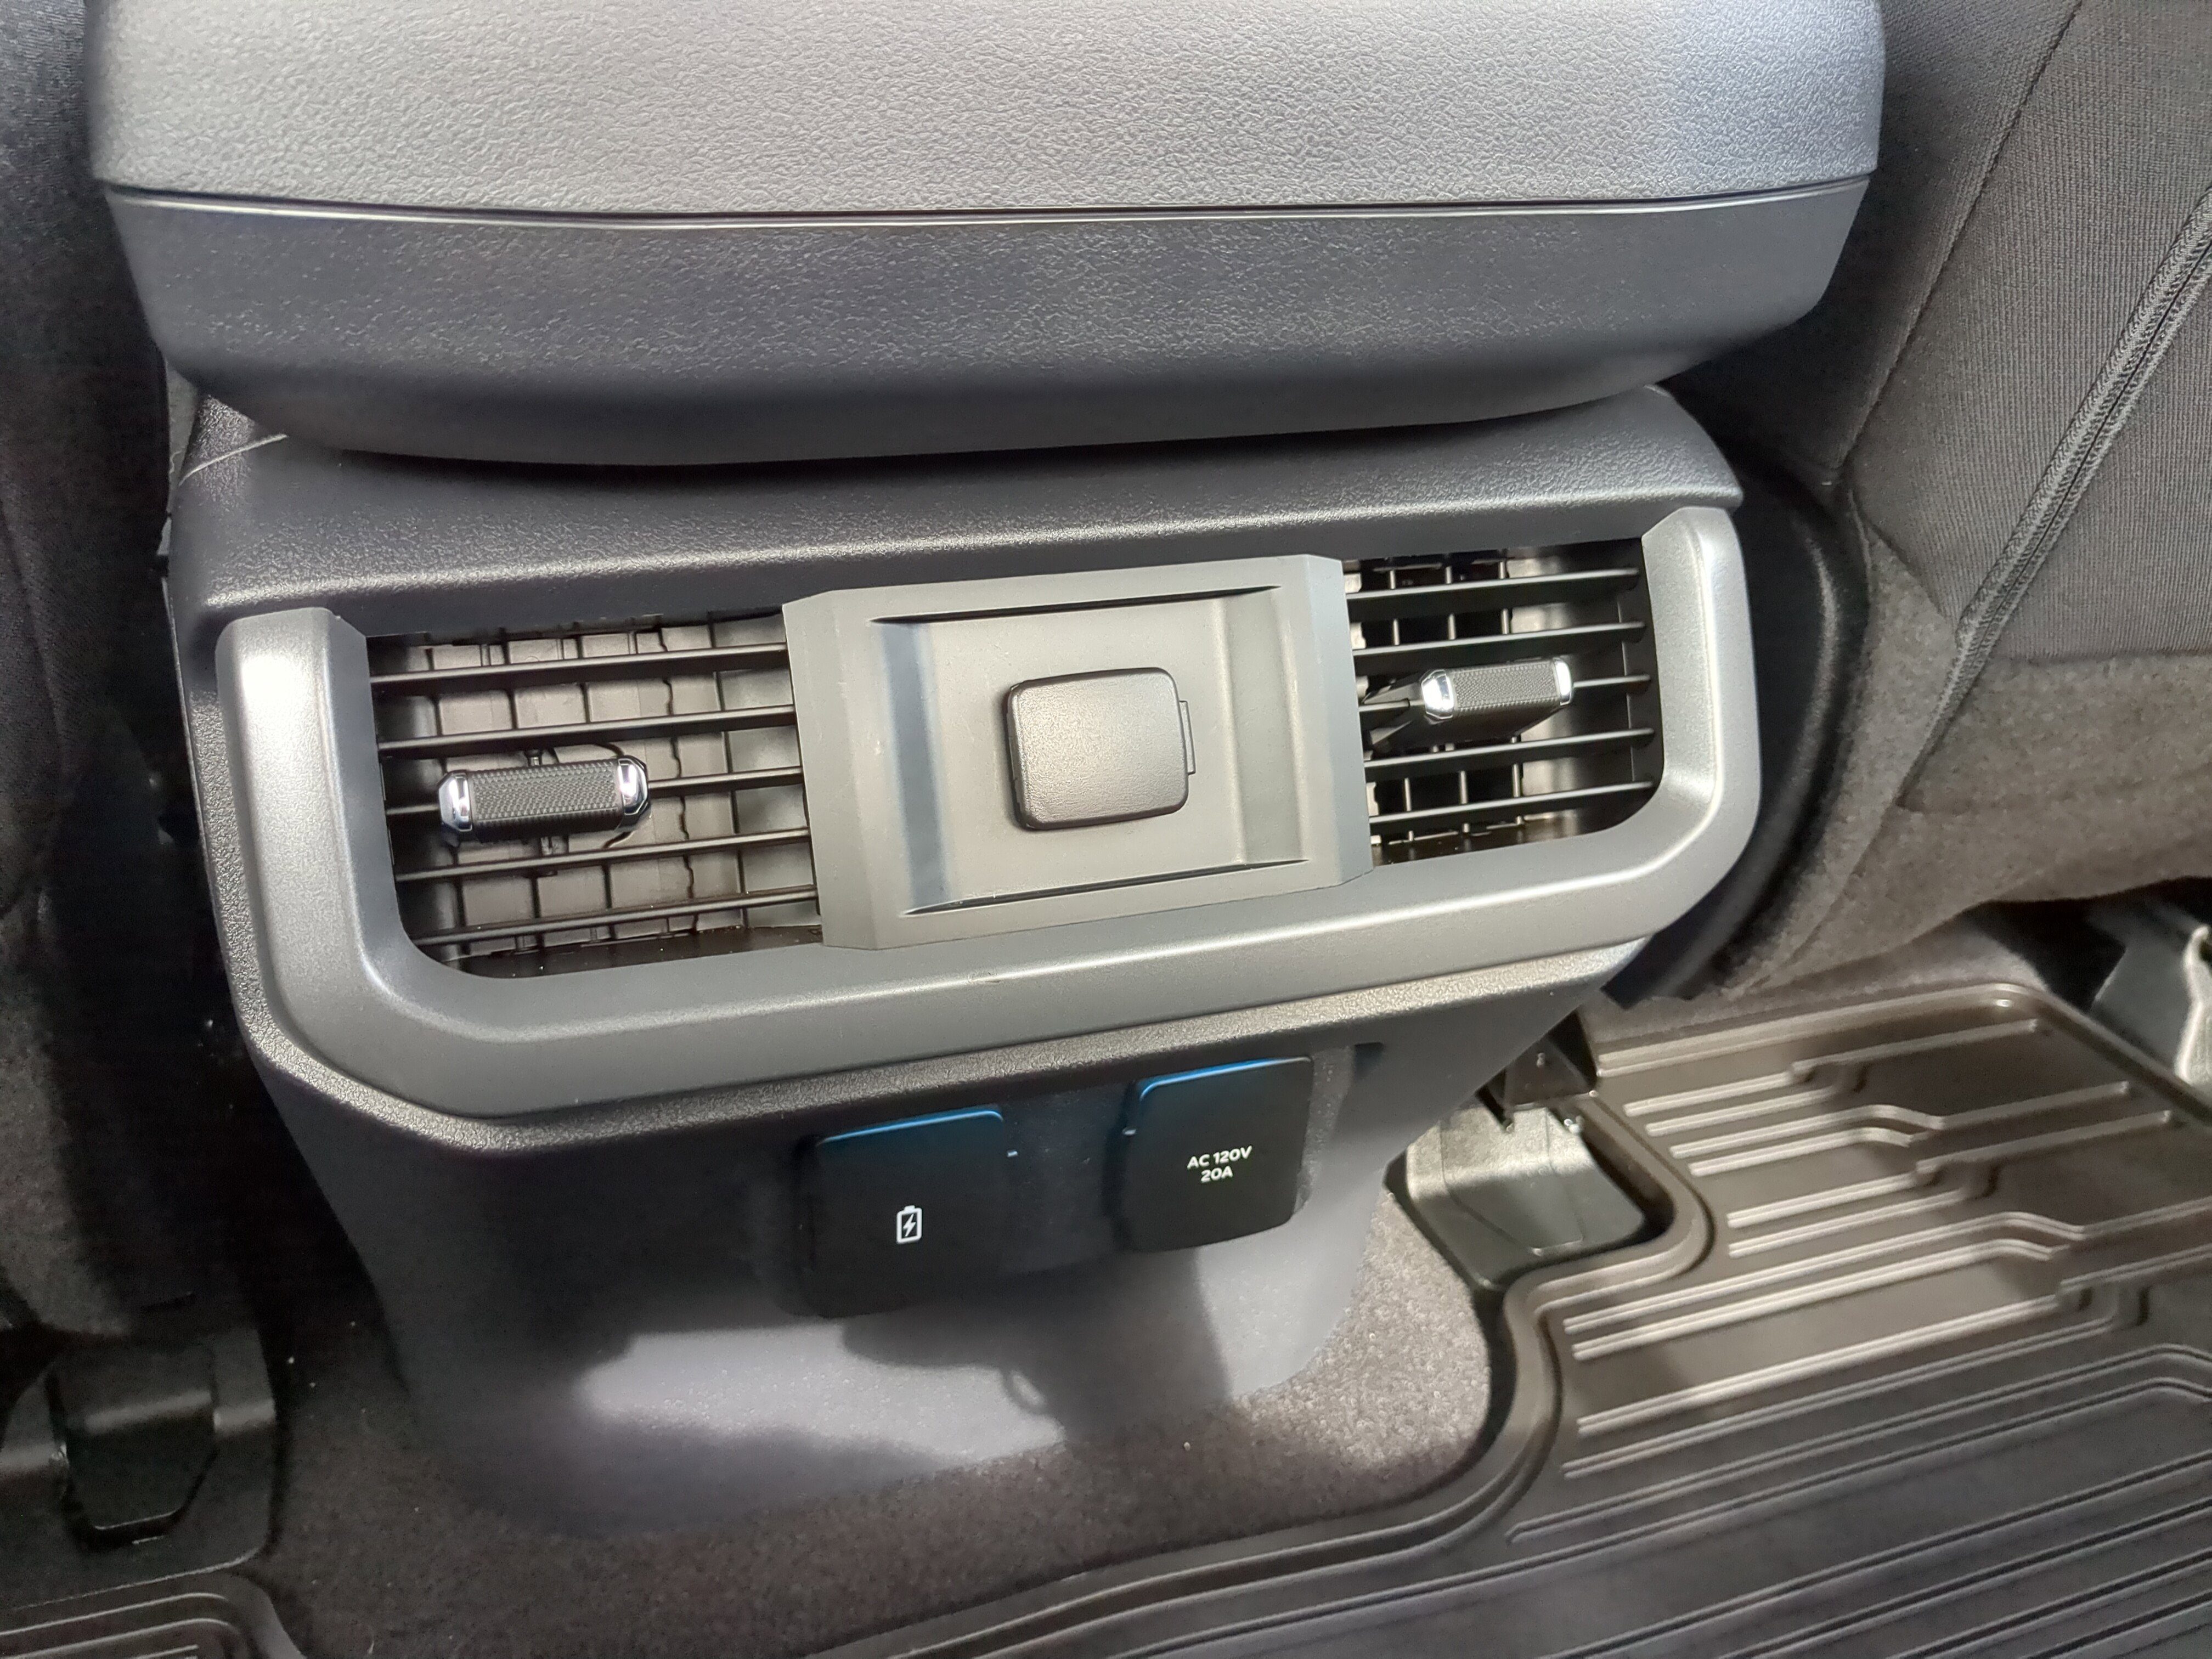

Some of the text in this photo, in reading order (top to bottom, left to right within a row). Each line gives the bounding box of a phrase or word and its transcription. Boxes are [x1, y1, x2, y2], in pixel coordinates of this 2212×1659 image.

[1187, 1146, 1252, 1169] AC 120V
[1200, 1165, 1233, 1183] 20A
